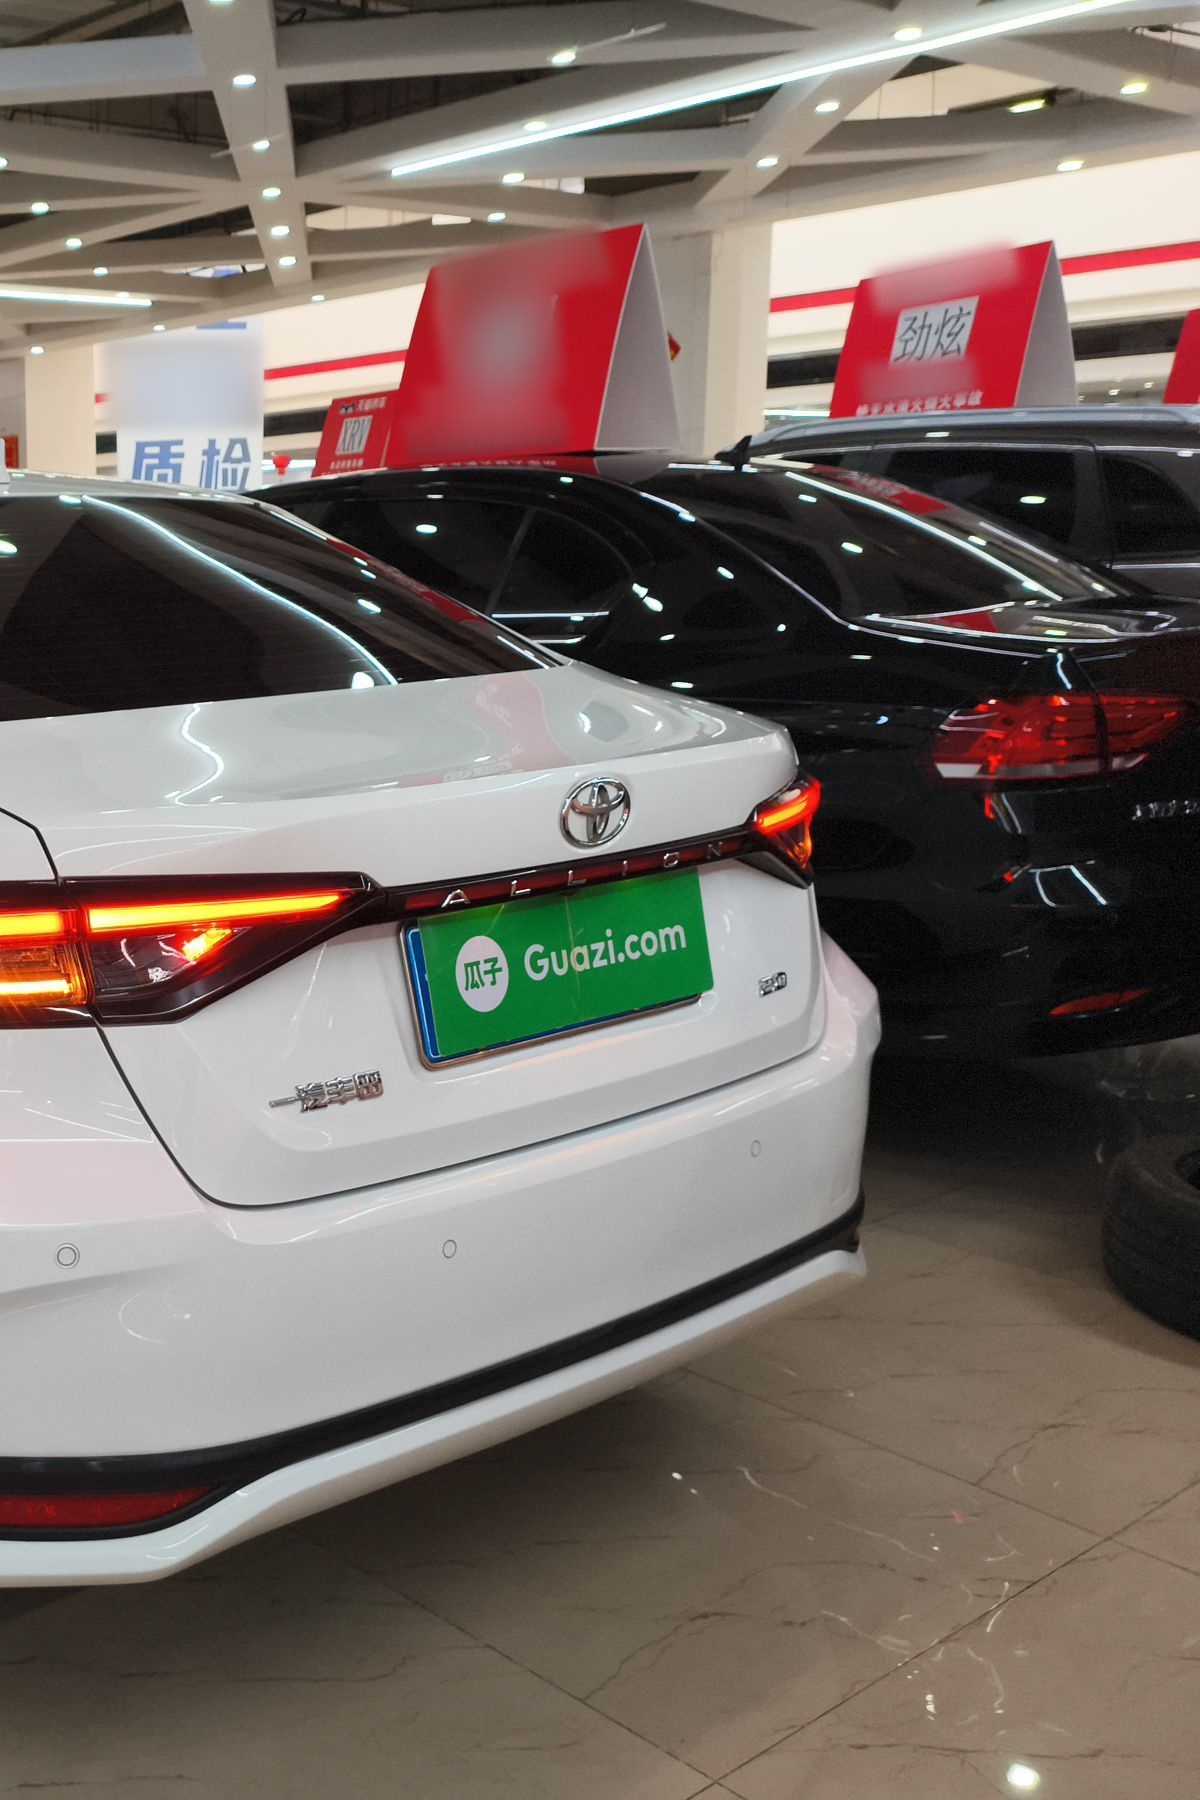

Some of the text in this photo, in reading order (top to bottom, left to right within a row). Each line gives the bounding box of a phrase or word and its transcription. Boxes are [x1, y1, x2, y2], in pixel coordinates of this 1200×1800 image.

[893, 306, 971, 362] 劲炫
[132, 438, 251, 493] 质检
[441, 842, 724, 908] ALLION
[464, 956, 503, 991] 瓜子
[524, 924, 687, 981] Guazi.com
[268, 1070, 384, 1114] 一汽丰田
